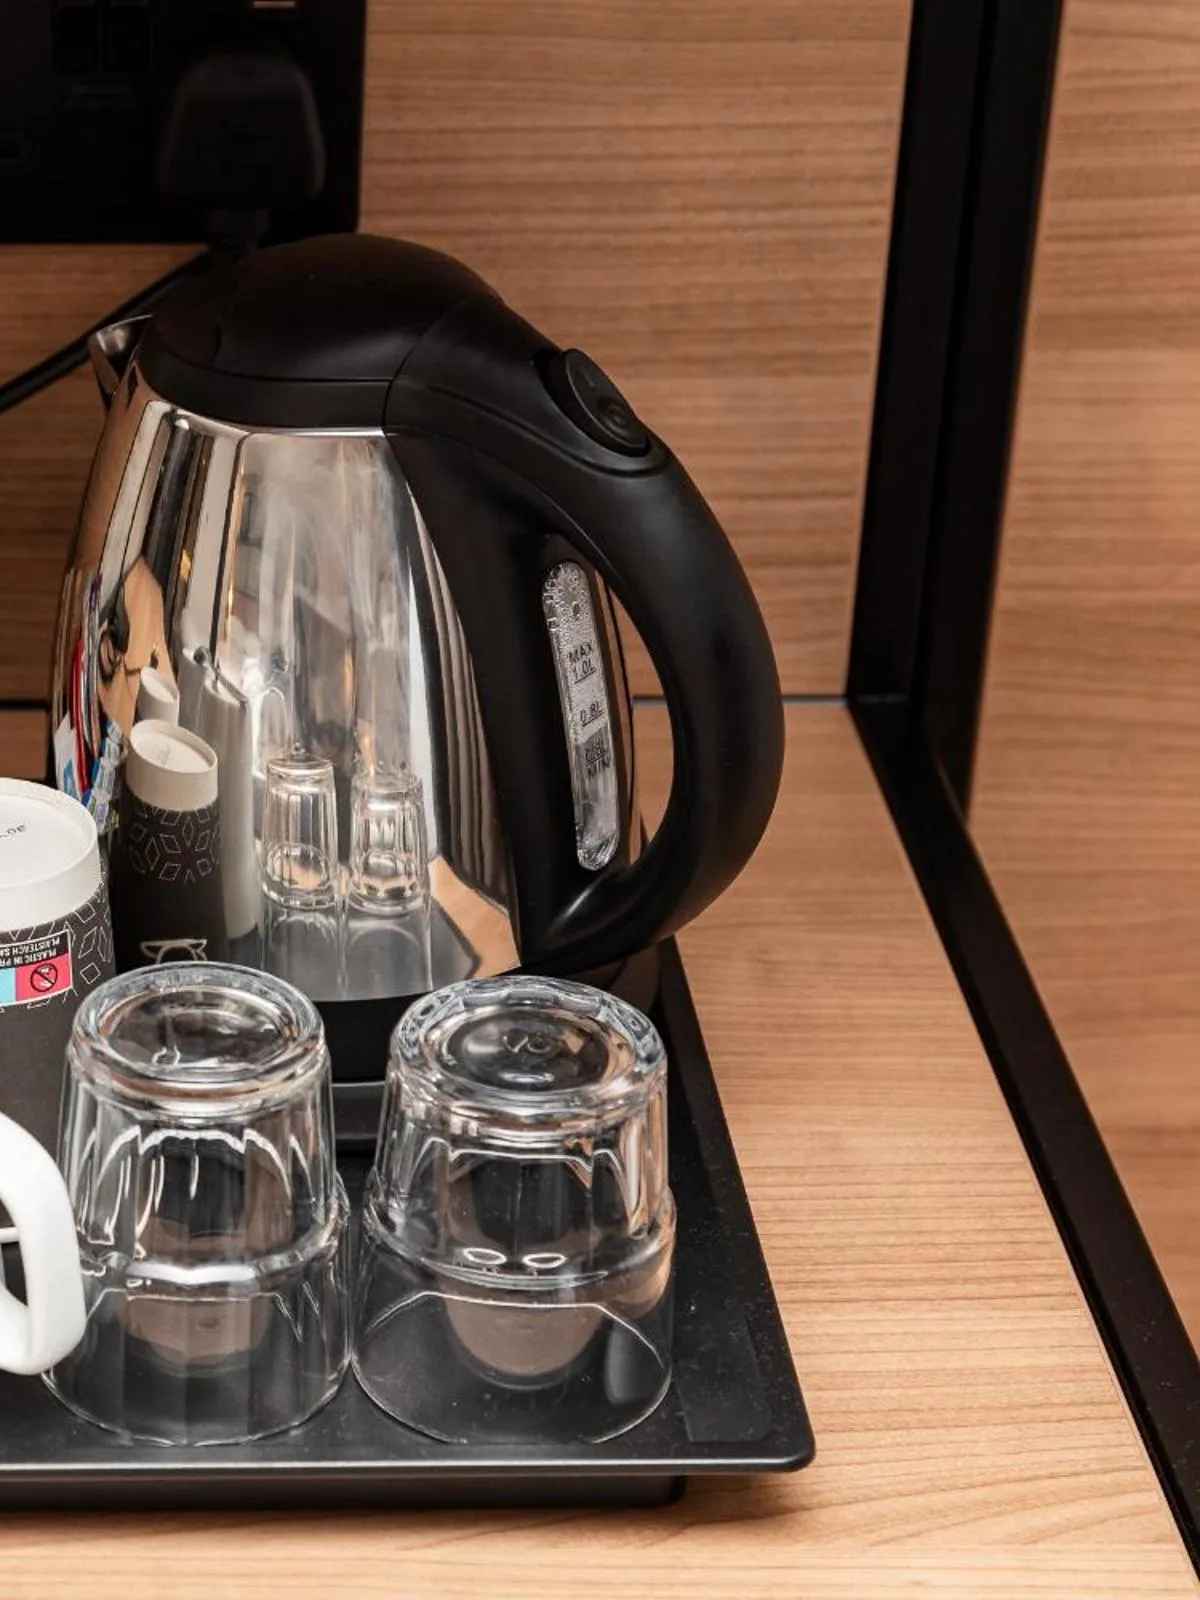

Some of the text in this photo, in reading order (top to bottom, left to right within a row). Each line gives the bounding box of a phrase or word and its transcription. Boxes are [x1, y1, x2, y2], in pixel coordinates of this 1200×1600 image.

[568, 643, 593, 664] MAX
[13, 956, 24, 966] IN
[24, 947, 57, 964] PLASTIC
